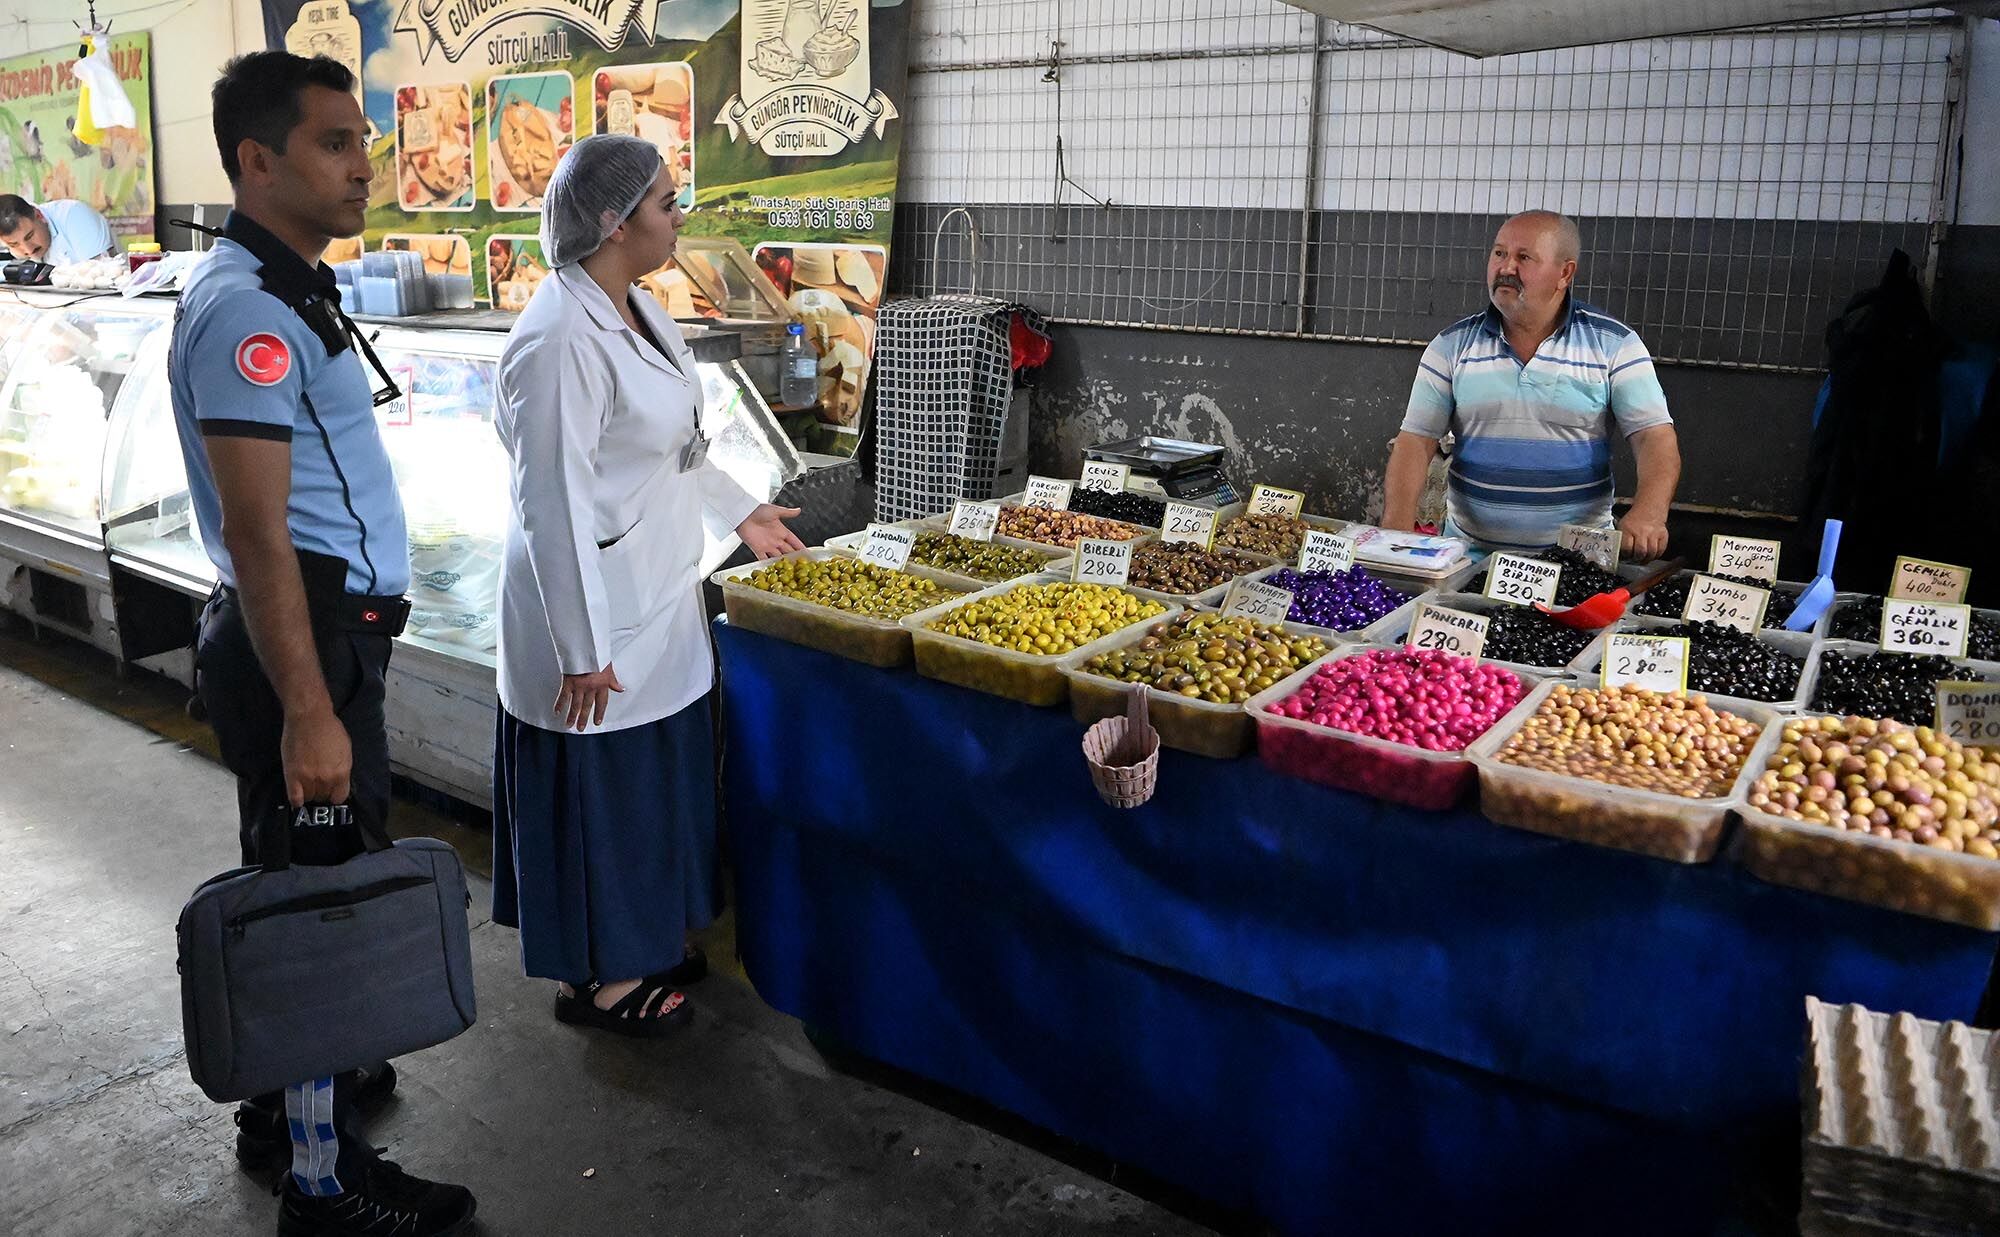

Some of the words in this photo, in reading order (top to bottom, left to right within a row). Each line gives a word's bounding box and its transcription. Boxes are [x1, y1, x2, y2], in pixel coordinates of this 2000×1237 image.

[488, 32, 527, 67] SÜTÇÜ
[533, 28, 571, 64] HALİL
[751, 95, 789, 131] GÜNGÖR
[793, 93, 860, 131] PEYNİRCİLİK
[775, 131, 804, 151] SÜTÇÜ
[806, 130, 828, 148] HALİL
[751, 196, 802, 210] WhatsApp
[806, 197, 823, 209] Süt
[826, 196, 865, 212] Sipariş
[769, 212, 800, 227] 0533
[804, 212, 830, 228] 161
[835, 212, 851, 228] 58
[855, 213, 874, 229] 63
[1087, 466, 1119, 477] CEVİZ
[871, 529, 908, 545] LİMONLU
[1311, 534, 1345, 549] YABAN
[1083, 543, 1127, 558] BİBERLİ
[1305, 546, 1350, 561] MERSİNLİ
[1498, 556, 1556, 578] MARMARA
[1903, 563, 1952, 579] GEMLİK
[1502, 568, 1542, 587] BİRLİK
[1239, 581, 1287, 600] KALAMATA
[1701, 582, 1747, 601] Jumbo
[1423, 607, 1485, 633] PANCARLI
[1891, 614, 1958, 630] GEMLİK
